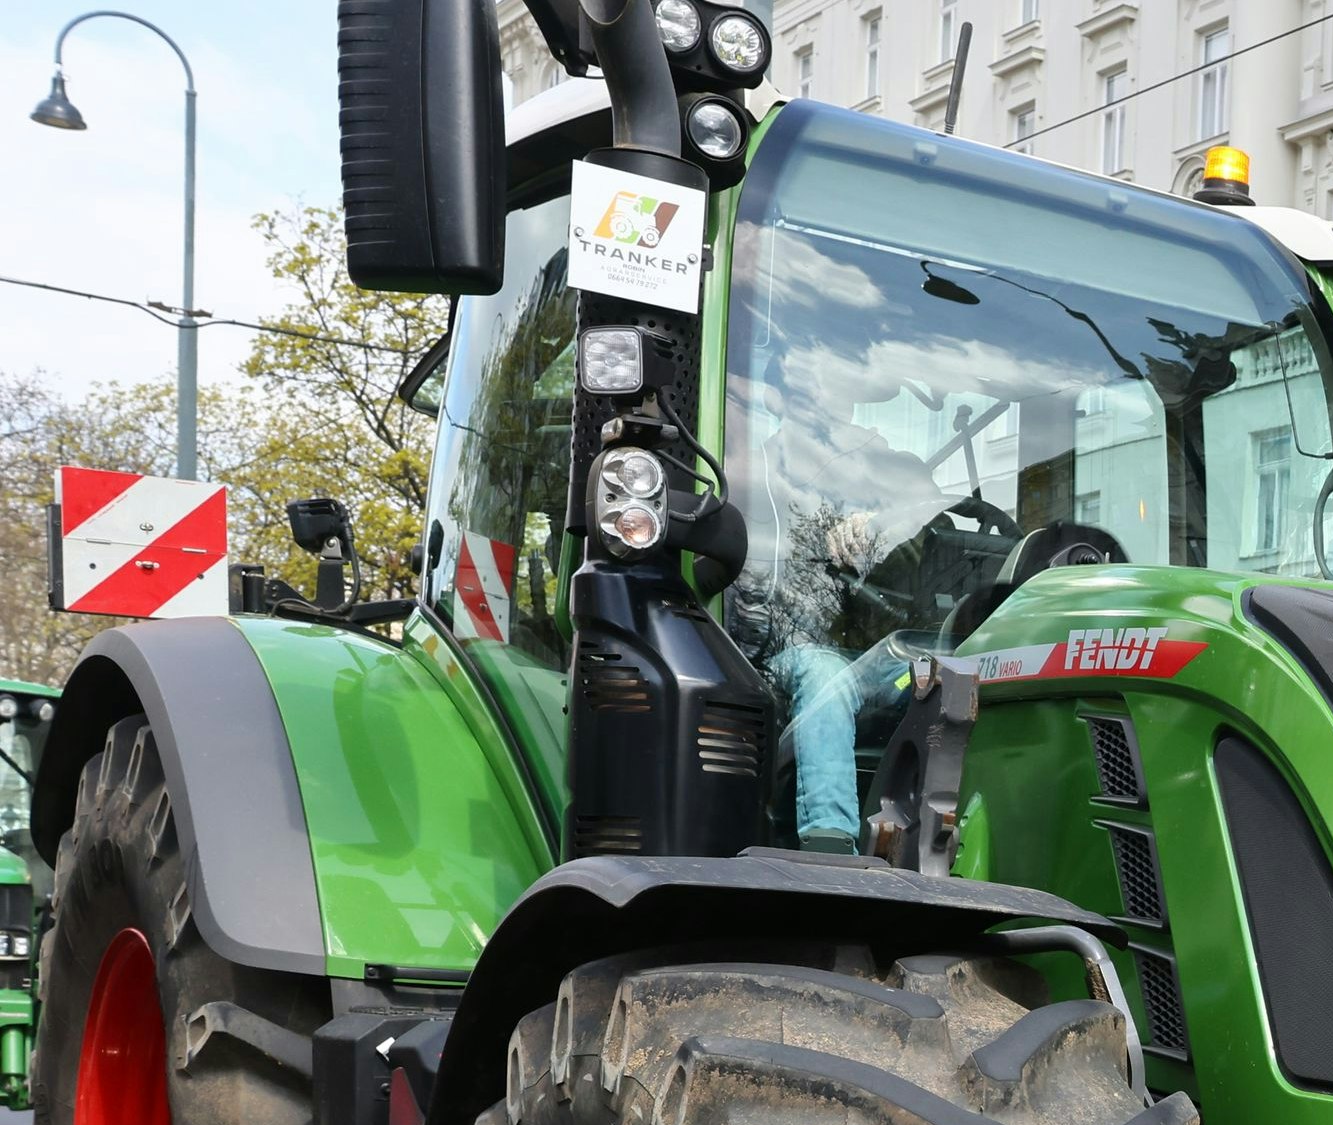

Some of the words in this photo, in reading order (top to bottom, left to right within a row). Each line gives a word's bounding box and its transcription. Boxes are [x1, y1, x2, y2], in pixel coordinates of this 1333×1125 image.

[579, 239, 688, 275] TRANKER
[622, 263, 646, 273] ROBIN
[607, 273, 625, 283] 0664
[1064, 627, 1169, 670] FENDT
[978, 656, 999, 679] 718
[999, 659, 1023, 677] VARIO
